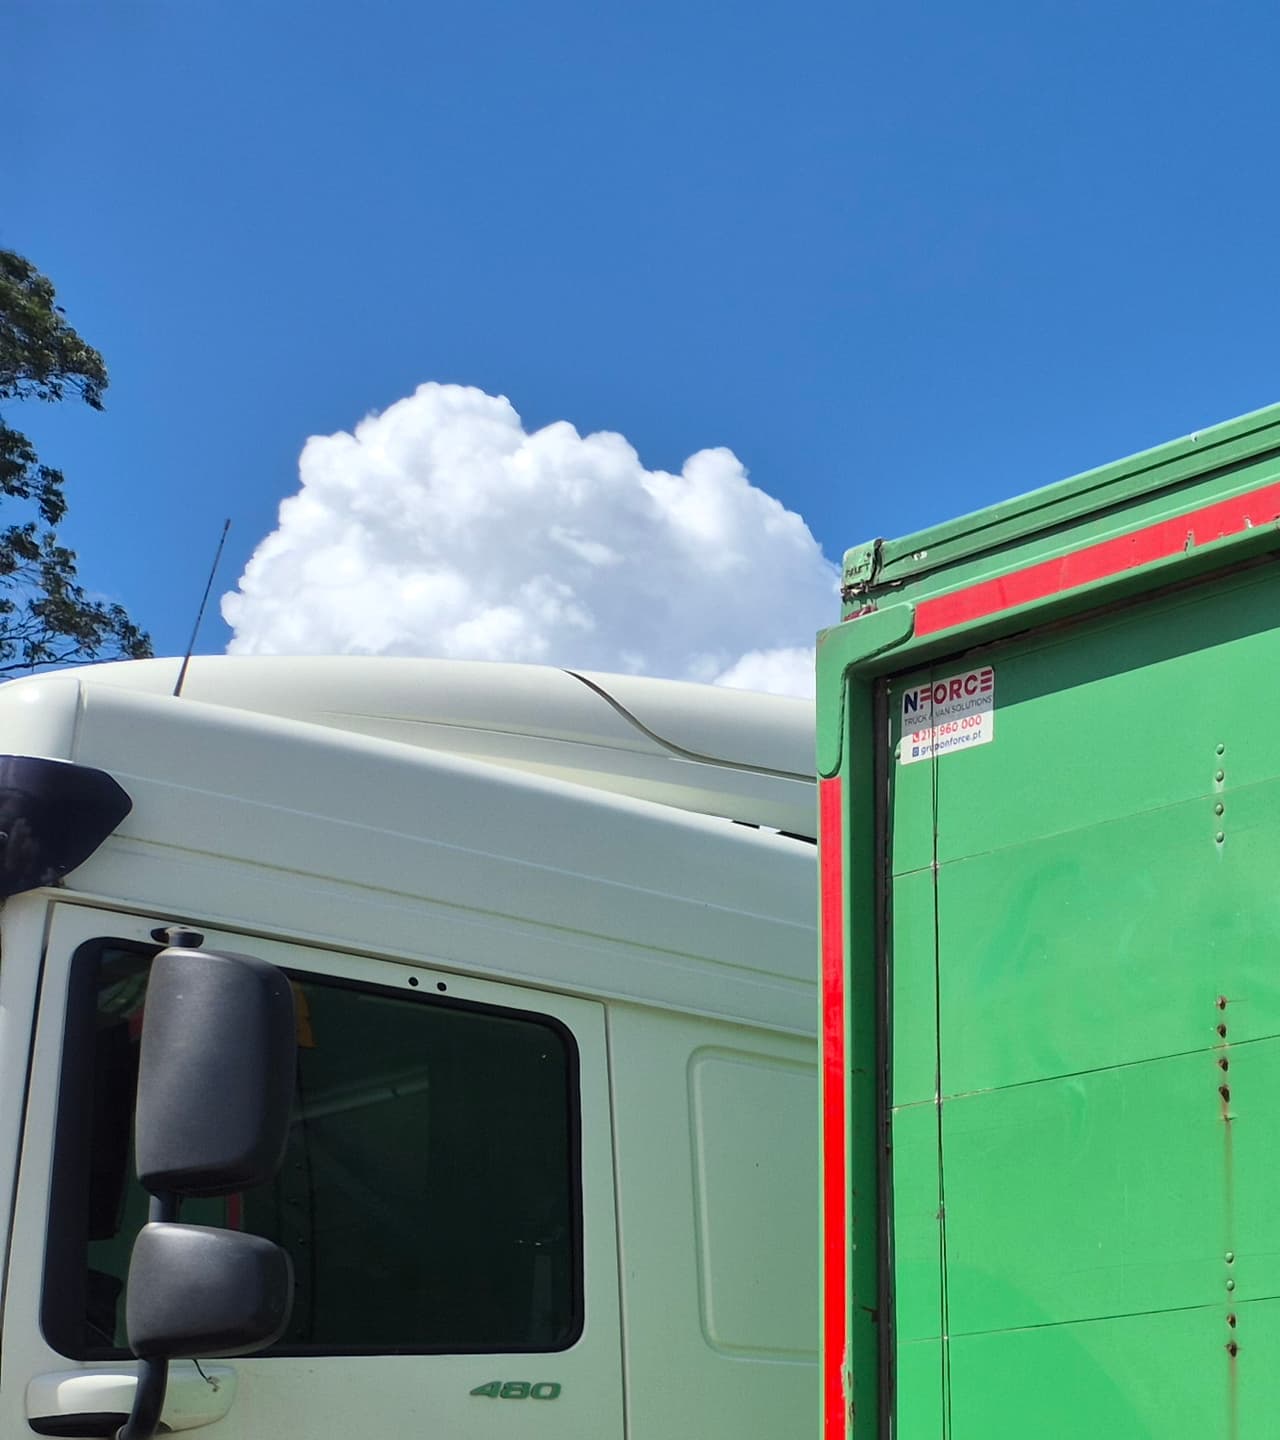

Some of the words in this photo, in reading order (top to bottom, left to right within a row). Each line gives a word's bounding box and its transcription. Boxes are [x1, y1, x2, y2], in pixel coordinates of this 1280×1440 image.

[904, 714, 928, 726] TRUCK
[935, 706, 951, 717] VAN
[951, 695, 993, 713] SOLUTIONS
[939, 722, 959, 736] 960
[961, 715, 983, 730] 000
[920, 730, 982, 756] gruponforce.pt
[469, 1381, 562, 1400] 480
